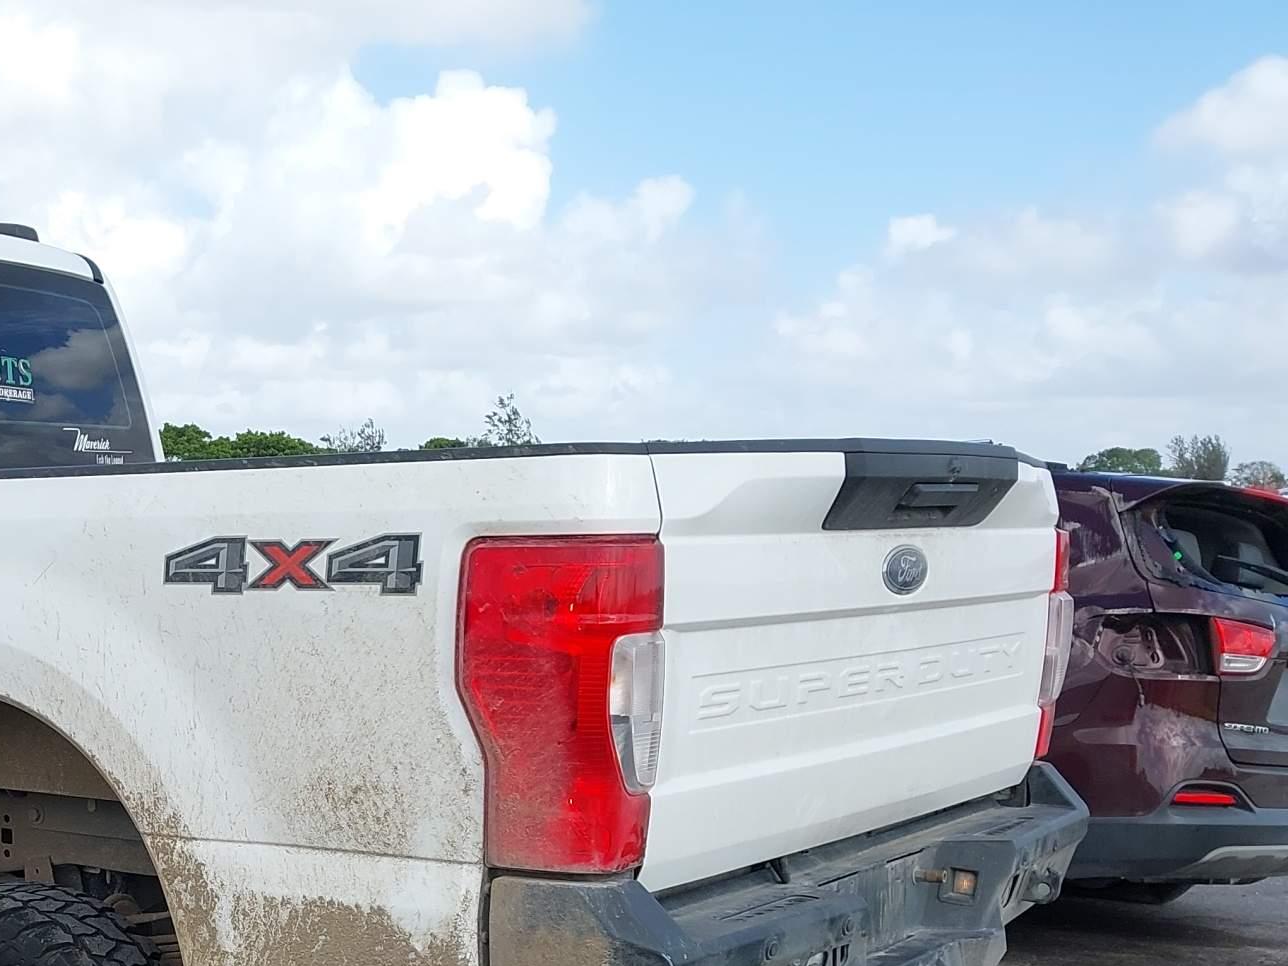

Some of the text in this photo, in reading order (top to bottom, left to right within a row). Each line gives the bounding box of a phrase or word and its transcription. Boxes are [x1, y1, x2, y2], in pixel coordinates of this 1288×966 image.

[63, 428, 111, 452] Maverick
[897, 555, 923, 583] Ford
[696, 641, 1022, 719] SUPER DUTY
